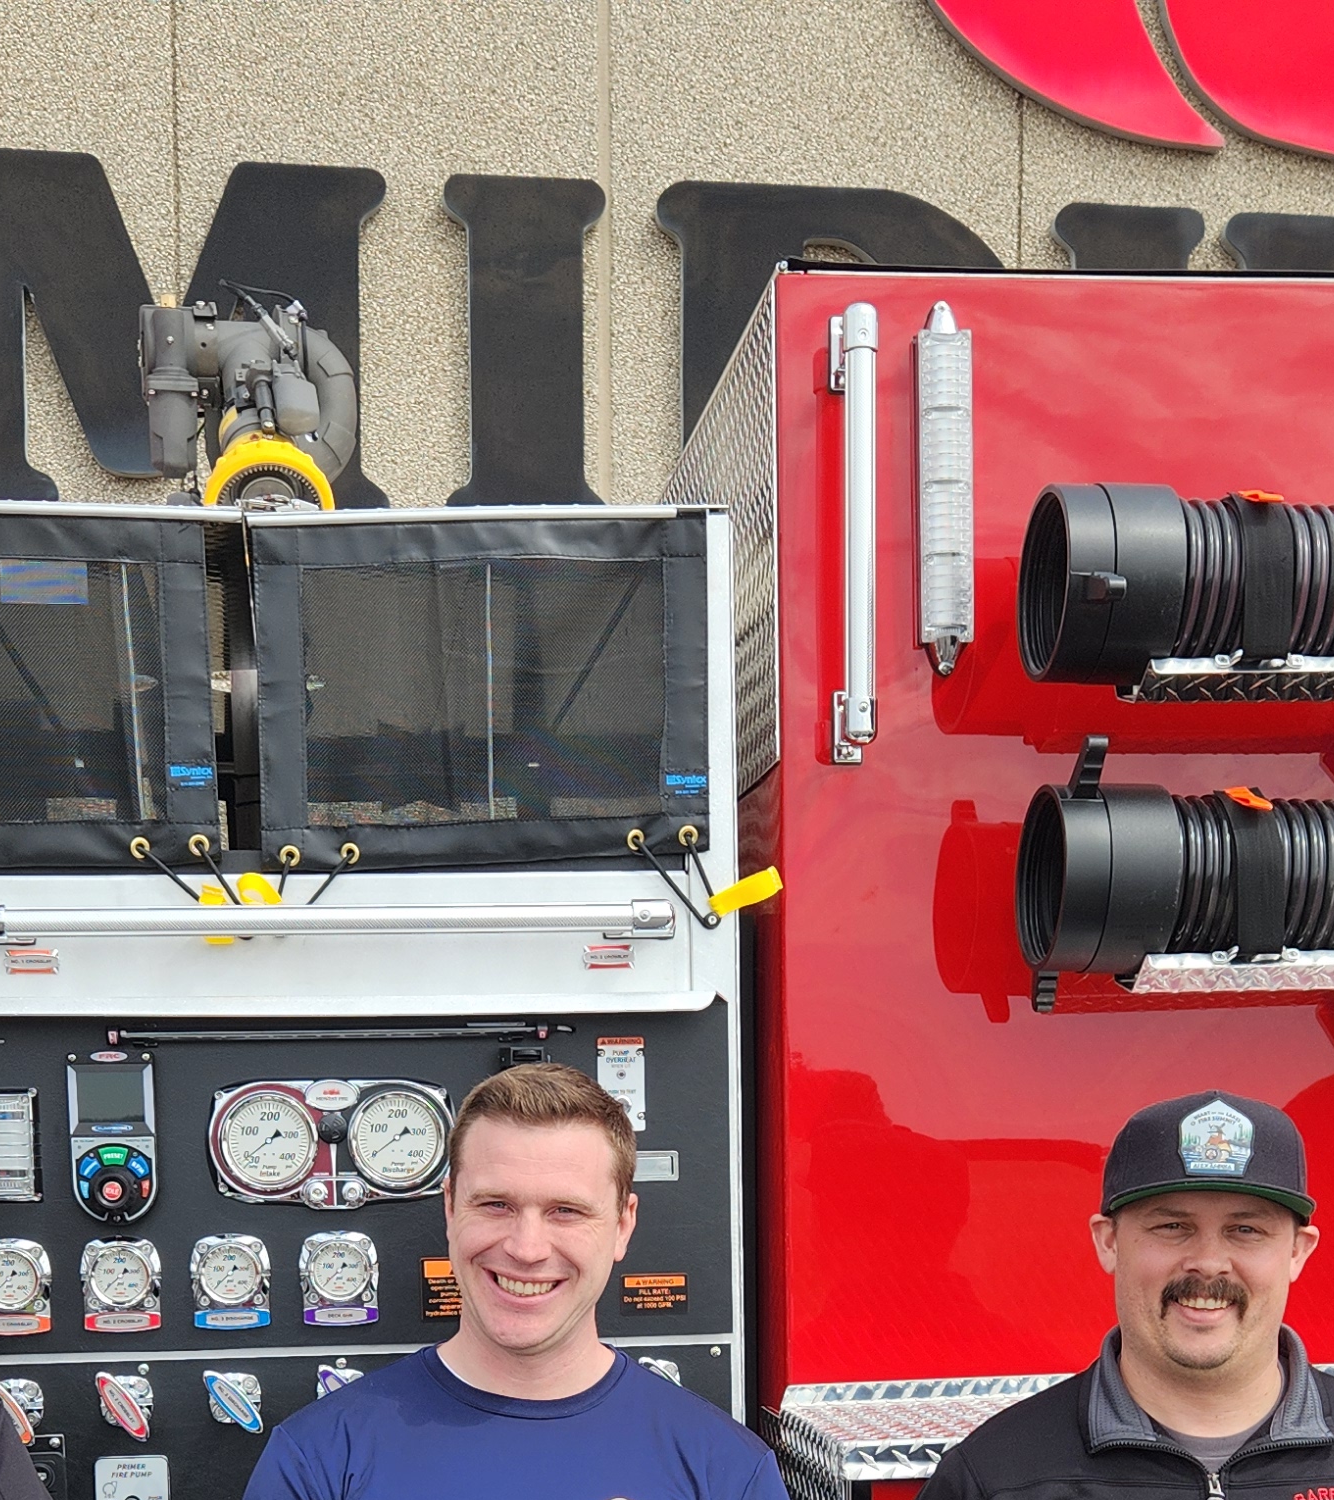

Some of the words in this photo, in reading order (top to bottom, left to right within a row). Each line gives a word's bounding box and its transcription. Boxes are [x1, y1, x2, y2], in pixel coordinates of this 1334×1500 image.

[260, 1111, 280, 1122] 200
[387, 1109, 408, 1119] 200
[240, 1126, 259, 1136] 100
[370, 1123, 388, 1133] 100
[411, 1127, 427, 1136] 300
[283, 1130, 299, 1139] 300
[279, 1152, 296, 1161] 400
[407, 1150, 424, 1158] 400
[382, 1165, 415, 1174] Discharge
